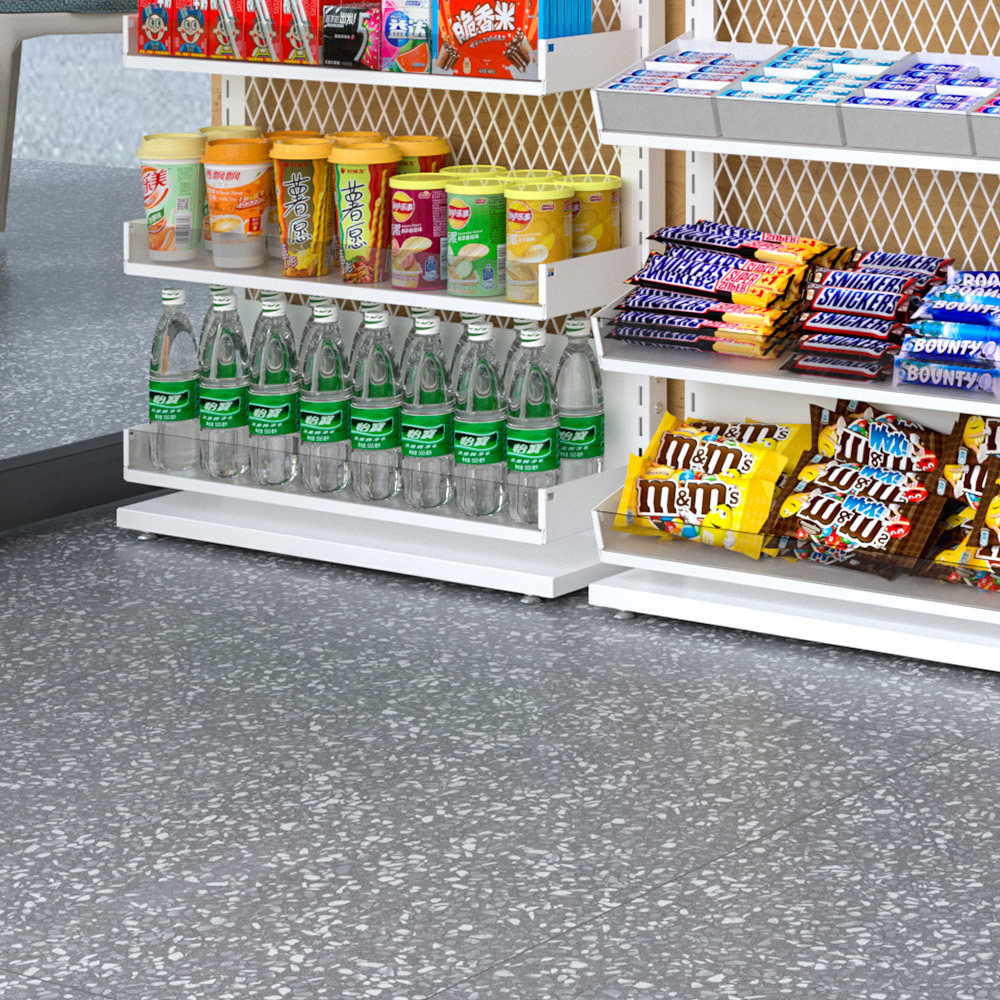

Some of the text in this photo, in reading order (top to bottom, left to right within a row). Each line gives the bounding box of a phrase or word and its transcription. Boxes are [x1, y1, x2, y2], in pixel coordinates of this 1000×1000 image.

[389, 19, 427, 39] 益达
[452, 1, 516, 44] 脆香米
[143, 168, 168, 194] 乐美
[650, 254, 728, 280] SNICKERS
[726, 269, 761, 285] SUPER
[863, 251, 942, 273] SNICKERS
[826, 271, 909, 293] SNICKERS
[816, 287, 900, 315] SNICKERS
[811, 312, 894, 334] SNICKERS
[913, 338, 983, 355] BOUNTY
[907, 365, 978, 387] BOUNTY
[655, 430, 755, 476] m&m's
[637, 477, 742, 517] m&m's
